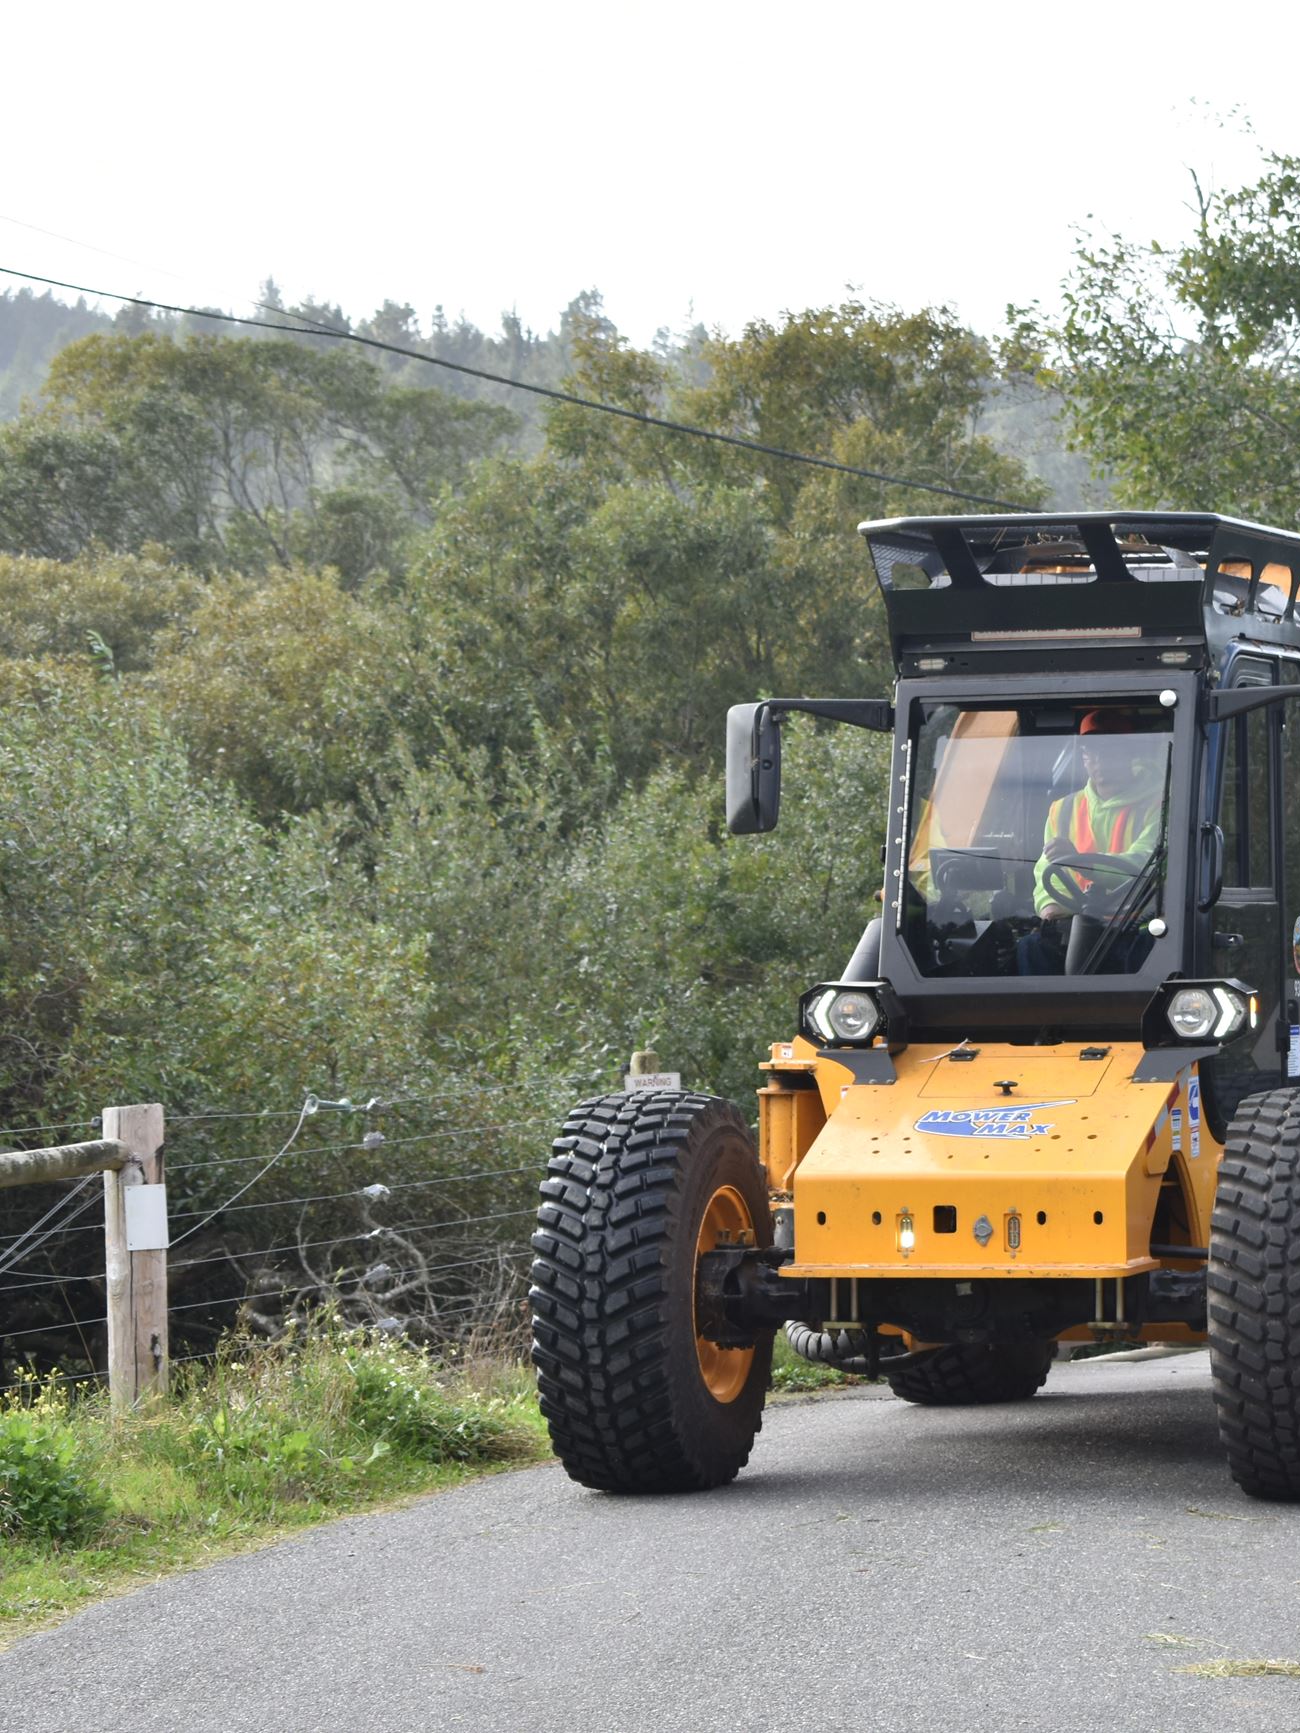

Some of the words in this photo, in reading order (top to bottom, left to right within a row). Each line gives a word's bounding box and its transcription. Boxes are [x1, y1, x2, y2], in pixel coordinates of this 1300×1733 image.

[634, 1077, 672, 1088] WARNING
[920, 1111, 1032, 1122] MOWER
[975, 1123, 1051, 1135] MAX
